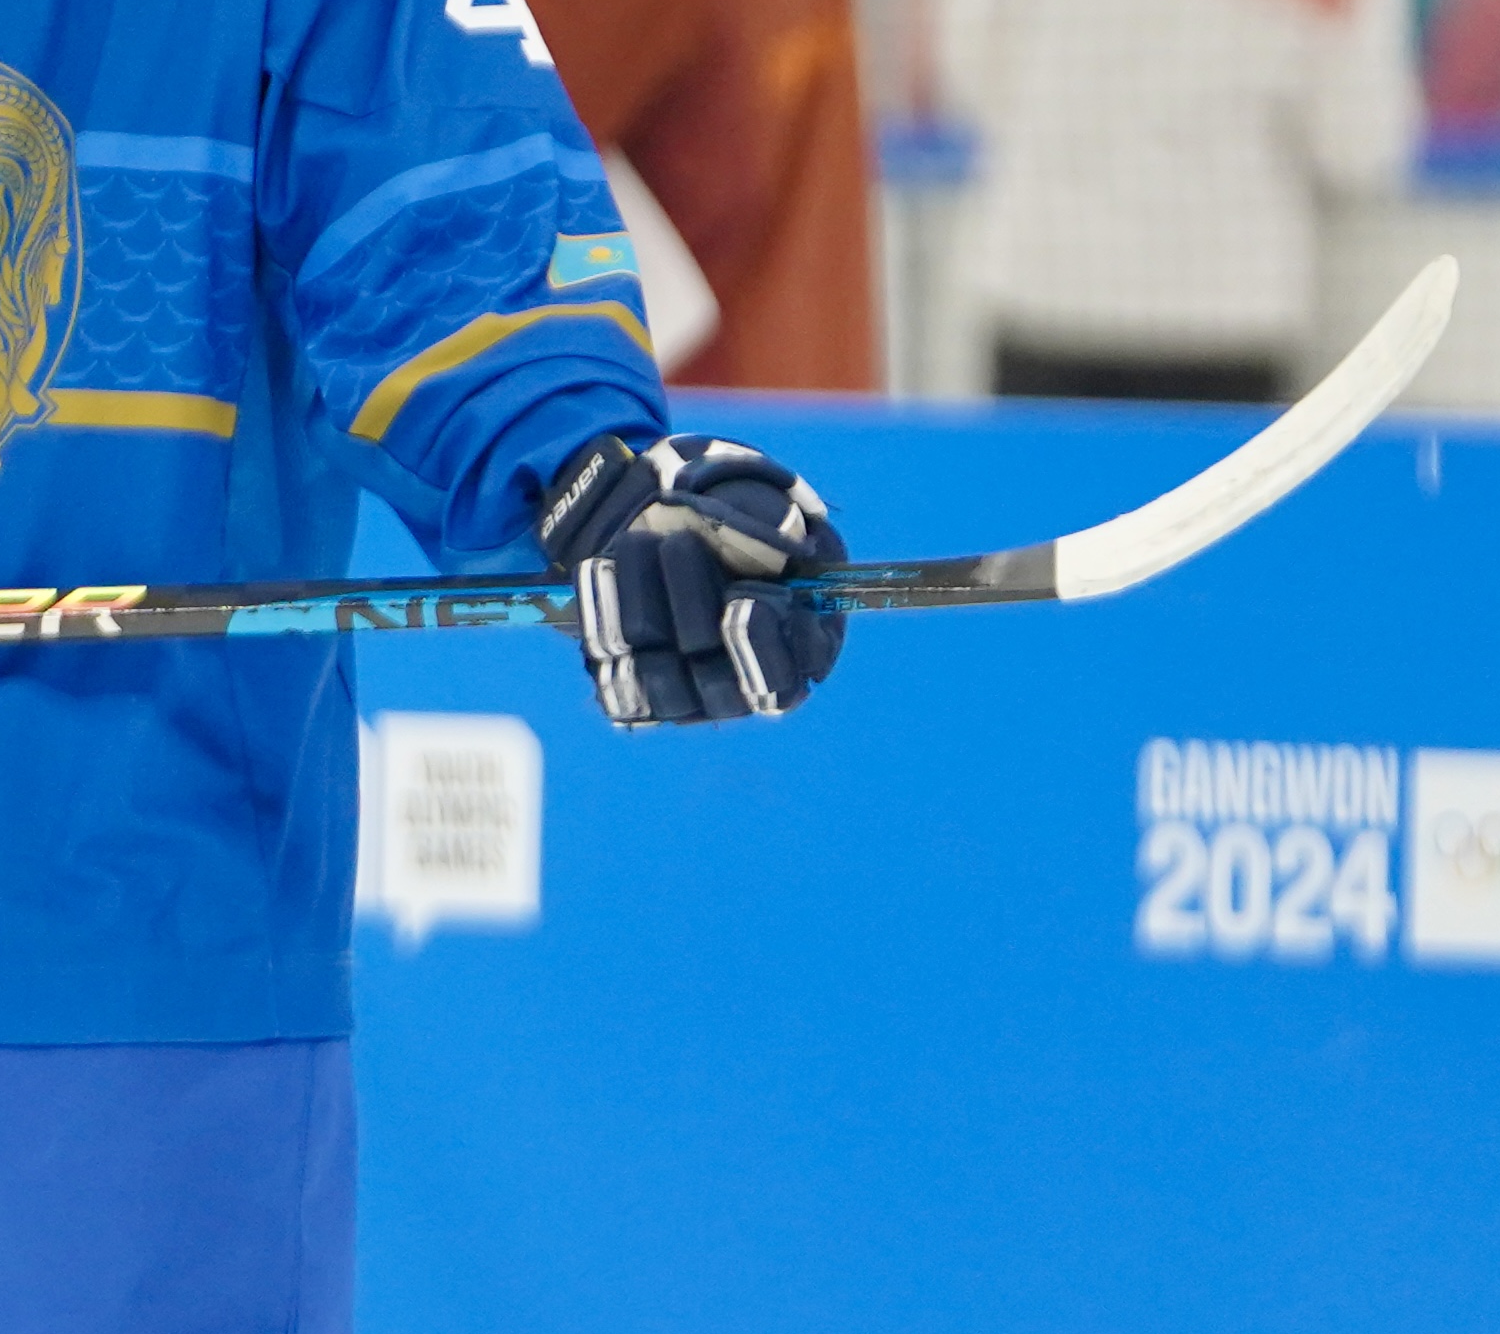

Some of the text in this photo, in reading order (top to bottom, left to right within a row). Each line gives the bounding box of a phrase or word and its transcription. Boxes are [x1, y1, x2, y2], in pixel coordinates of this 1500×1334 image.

[540, 452, 606, 541] BAUER
[1141, 736, 1399, 825] GANGWON
[1138, 822, 1396, 955] 2024
